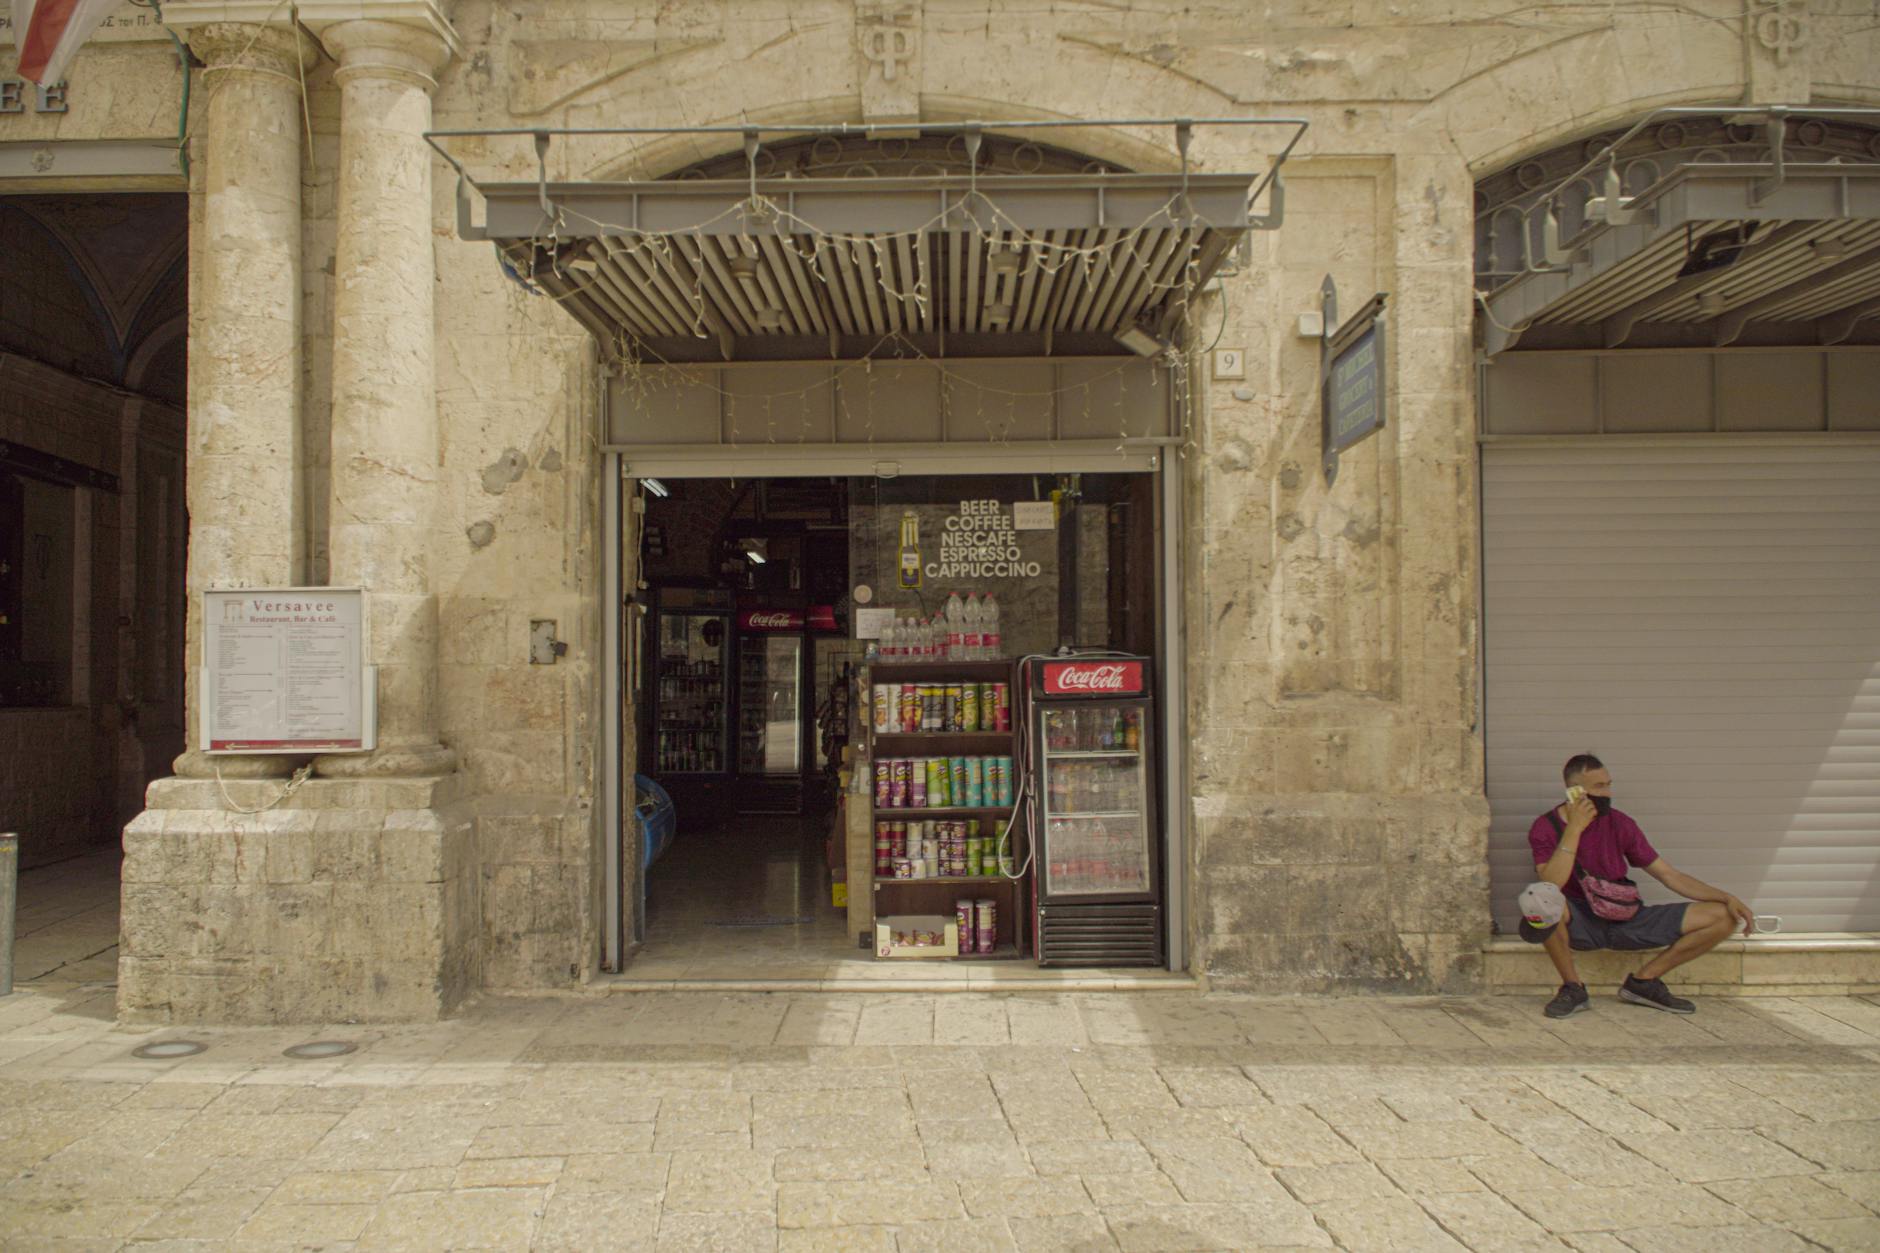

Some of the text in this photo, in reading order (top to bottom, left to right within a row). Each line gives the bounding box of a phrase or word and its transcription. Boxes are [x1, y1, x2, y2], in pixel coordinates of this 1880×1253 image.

[1224, 354, 1233, 370] 9
[960, 500, 999, 515] BEER
[945, 516, 1010, 531] COFFEE
[941, 531, 1016, 547] NESCAFE
[940, 547, 1021, 562] ESPRESSO
[925, 562, 1041, 578] CAPPUCCINO
[253, 600, 334, 612] Versavee
[294, 615, 308, 623] Bar
